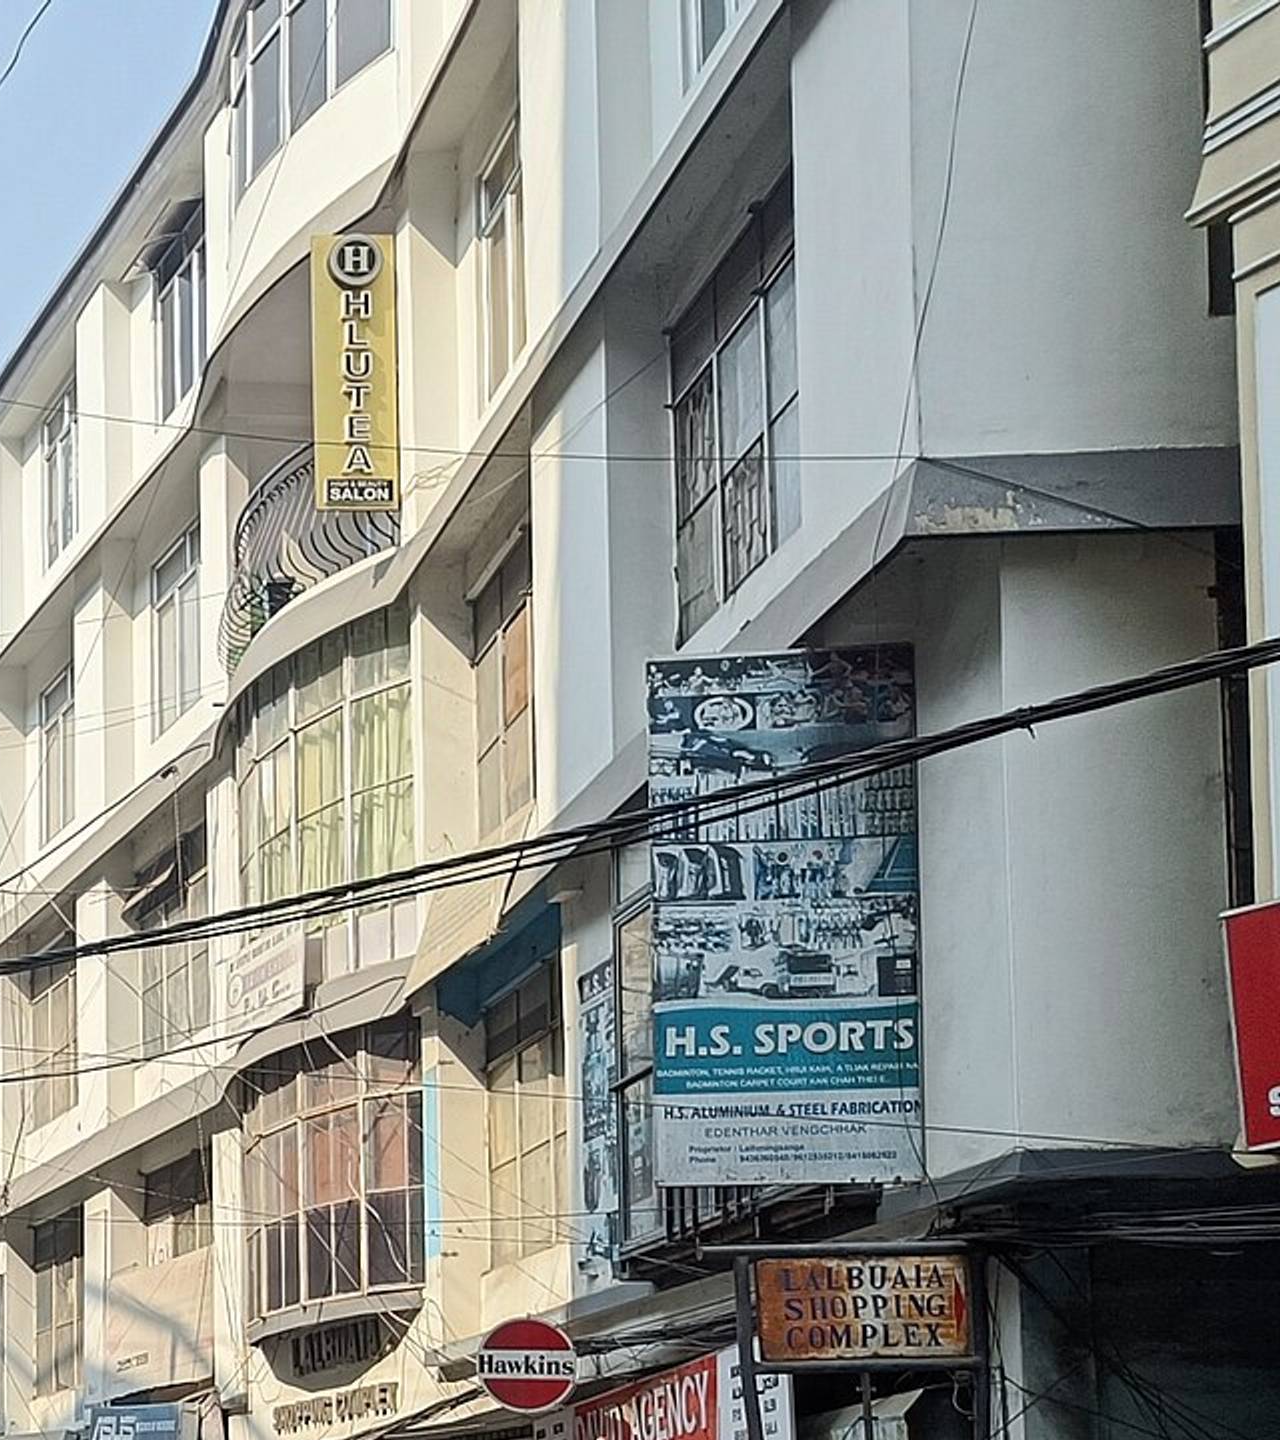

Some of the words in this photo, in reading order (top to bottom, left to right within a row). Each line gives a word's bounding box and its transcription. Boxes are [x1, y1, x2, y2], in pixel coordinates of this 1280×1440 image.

[342, 245, 371, 273] H
[341, 289, 373, 475] HLUTEA
[329, 487, 390, 501] SALON
[664, 1023, 742, 1058] H.S.
[753, 1017, 915, 1056] SPORTS
[788, 1101, 829, 1117] STEEL
[704, 1124, 778, 1139] EDENTHAR
[782, 1263, 945, 1292] LALBUAIA
[783, 1293, 946, 1322] SHOPPING
[786, 1321, 944, 1351] COMPLEX
[478, 1353, 575, 1377] Hawkins
